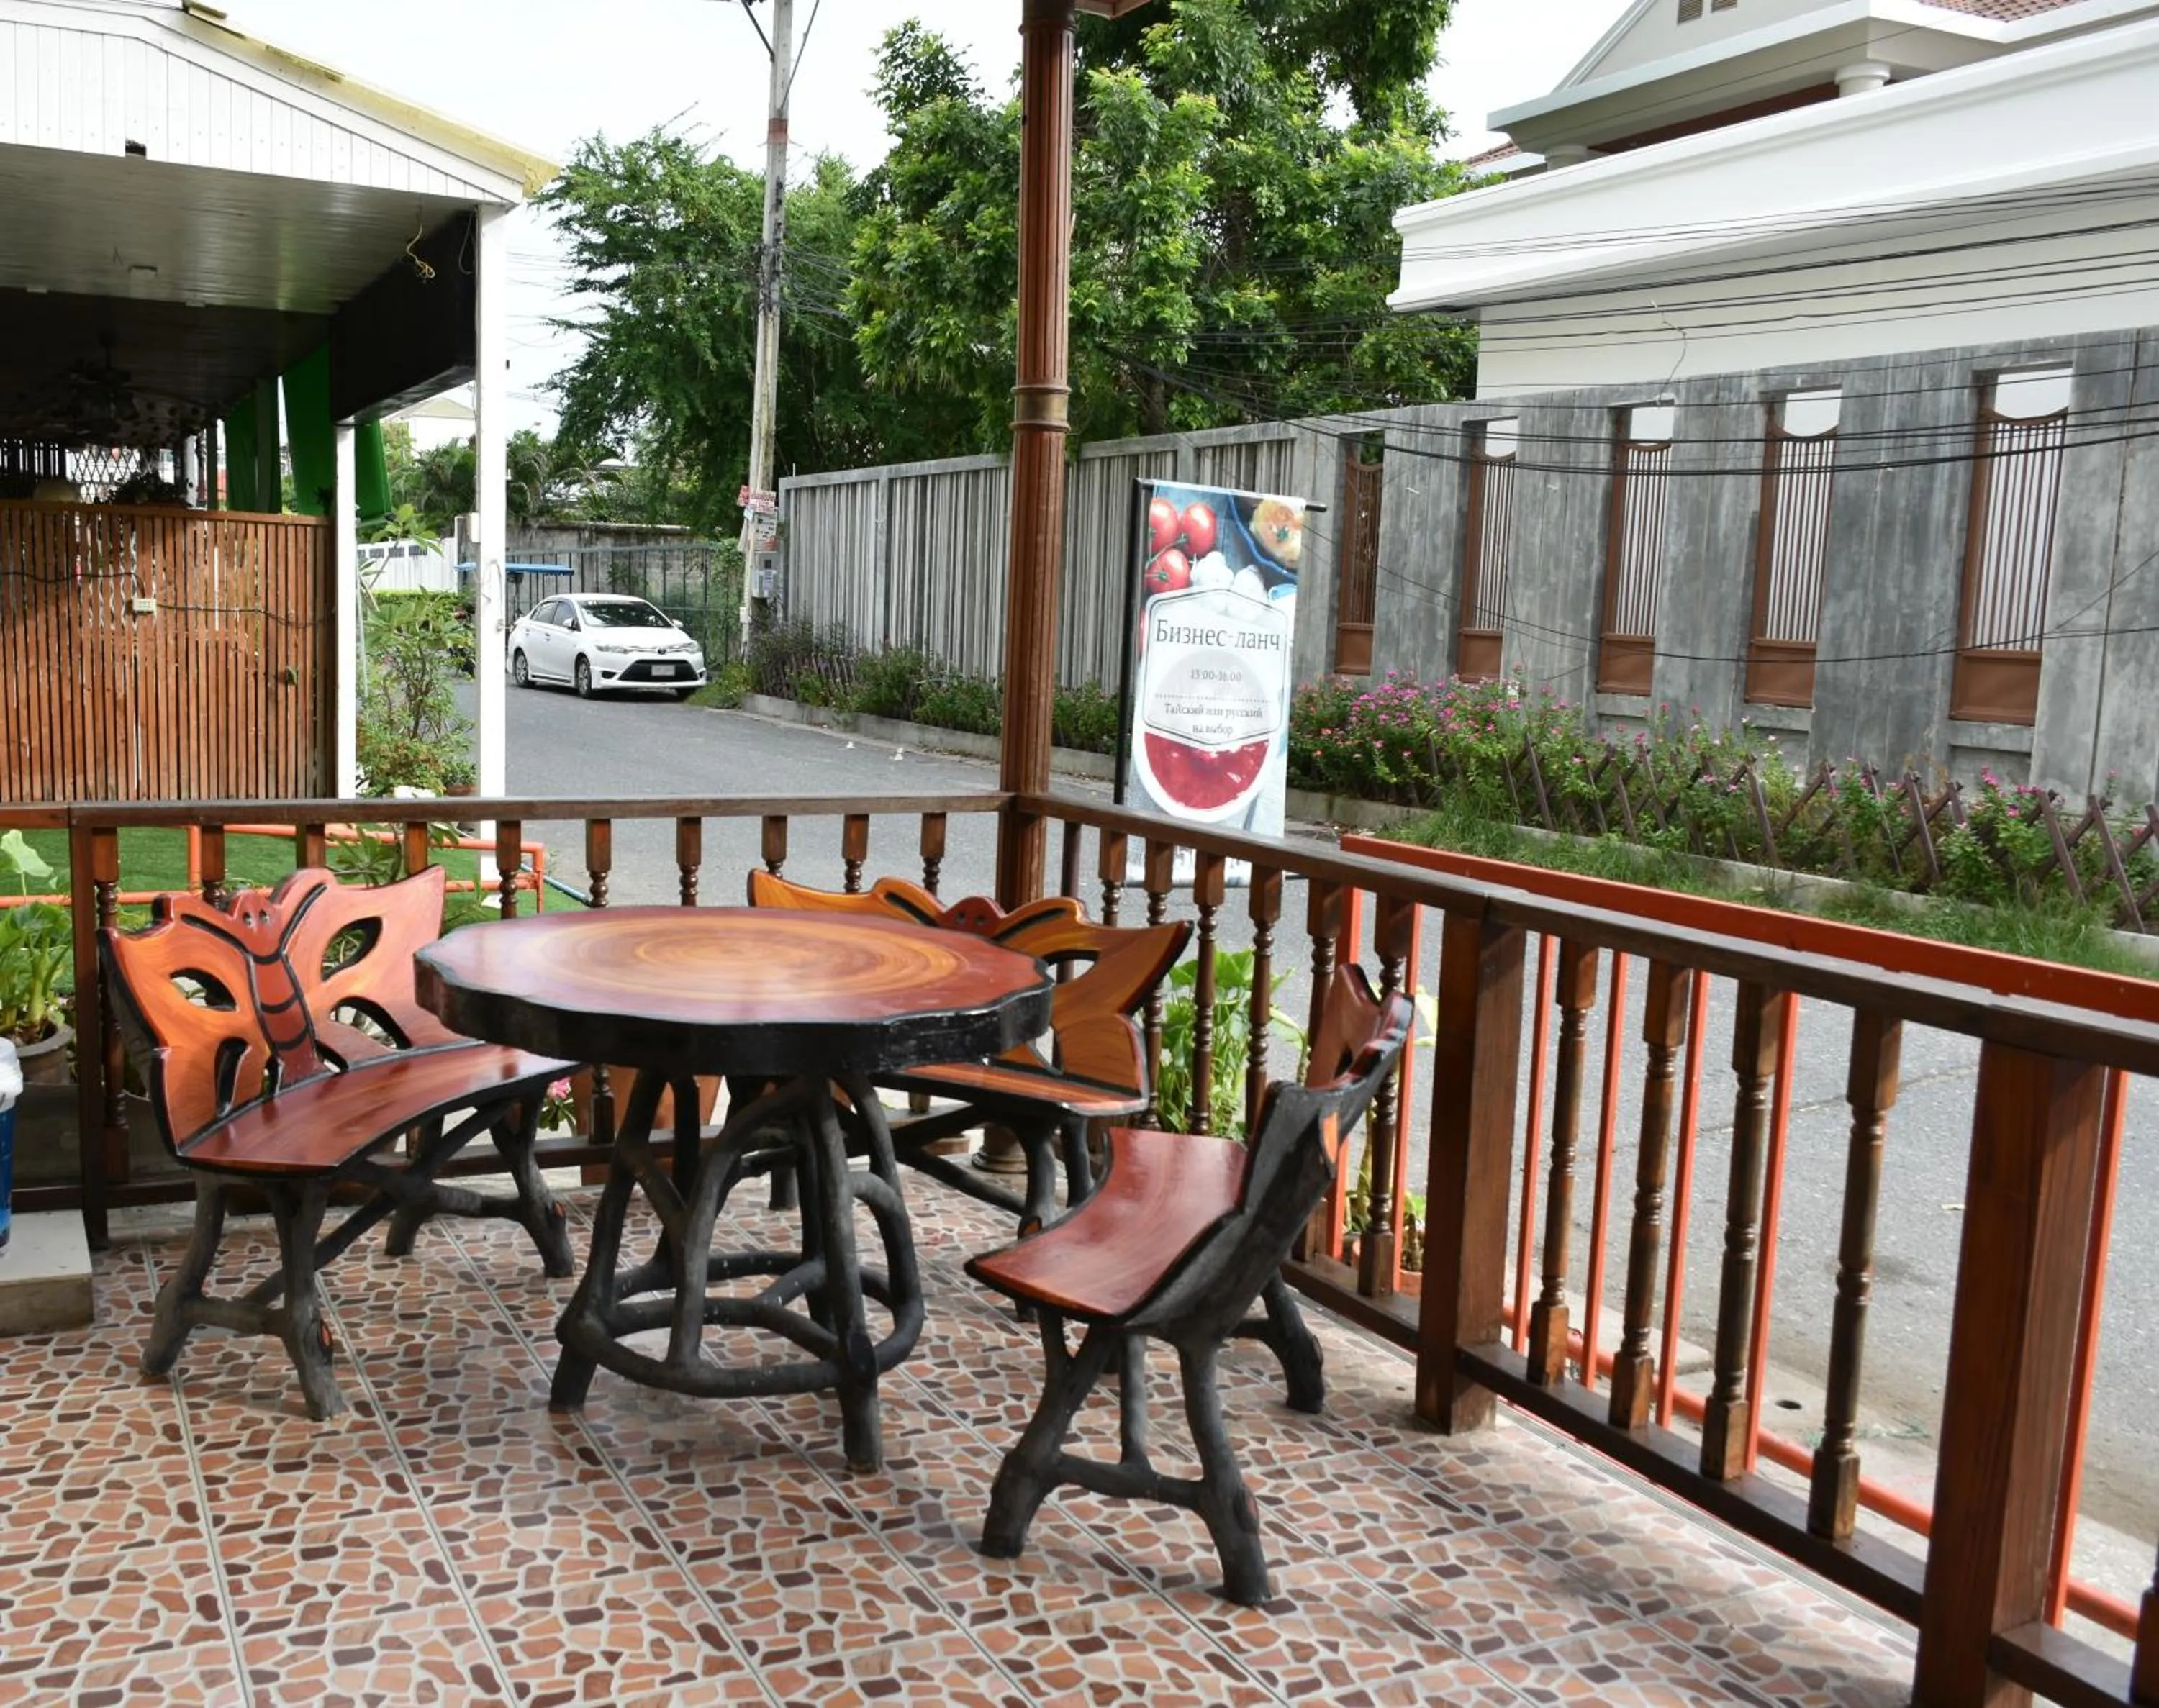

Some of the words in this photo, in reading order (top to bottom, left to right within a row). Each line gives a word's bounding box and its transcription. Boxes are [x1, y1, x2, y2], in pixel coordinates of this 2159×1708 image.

[1157, 619, 1280, 650] Бизнес-ланч
[1164, 703, 1204, 715] Тайский
[1226, 708, 1263, 719] русский
[1192, 724, 1204, 733] на
[1206, 723, 1233, 737] выбор
